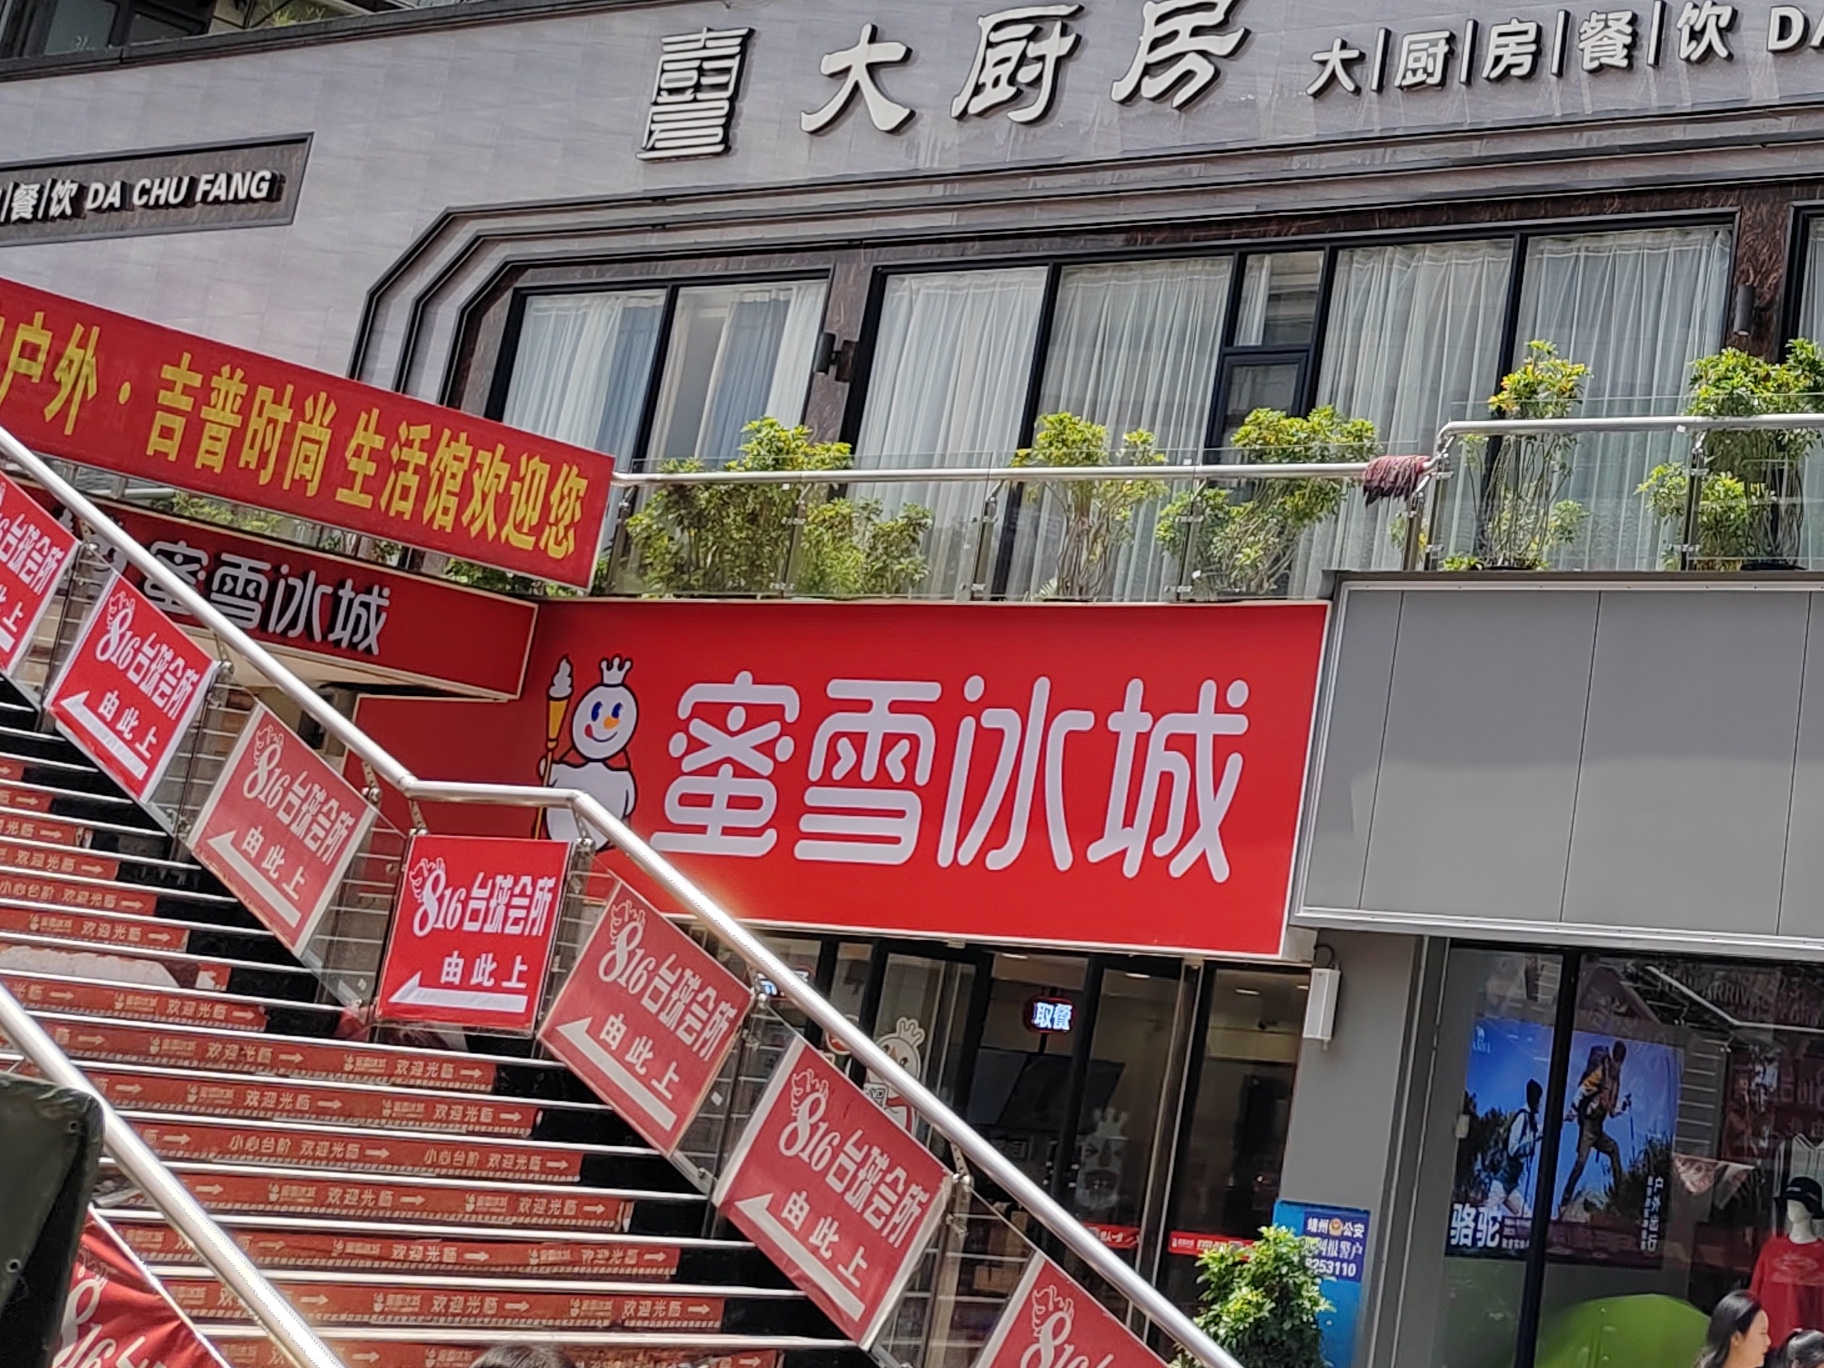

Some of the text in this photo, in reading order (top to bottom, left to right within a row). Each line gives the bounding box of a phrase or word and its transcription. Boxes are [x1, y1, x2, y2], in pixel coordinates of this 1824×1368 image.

[85, 181, 122, 210] DA
[132, 176, 190, 206] CHU
[195, 170, 273, 202] FANG
[97, 688, 161, 759] 由此上
[650, 668, 1251, 883] 蜜雪冰城
[241, 824, 308, 901] 由此上
[439, 950, 529, 989] 由此上
[1032, 1000, 1074, 1032] 取餐
[600, 1012, 680, 1101] 由此上
[780, 1190, 872, 1290] 由此上
[1450, 1202, 1501, 1248] 骆驼
